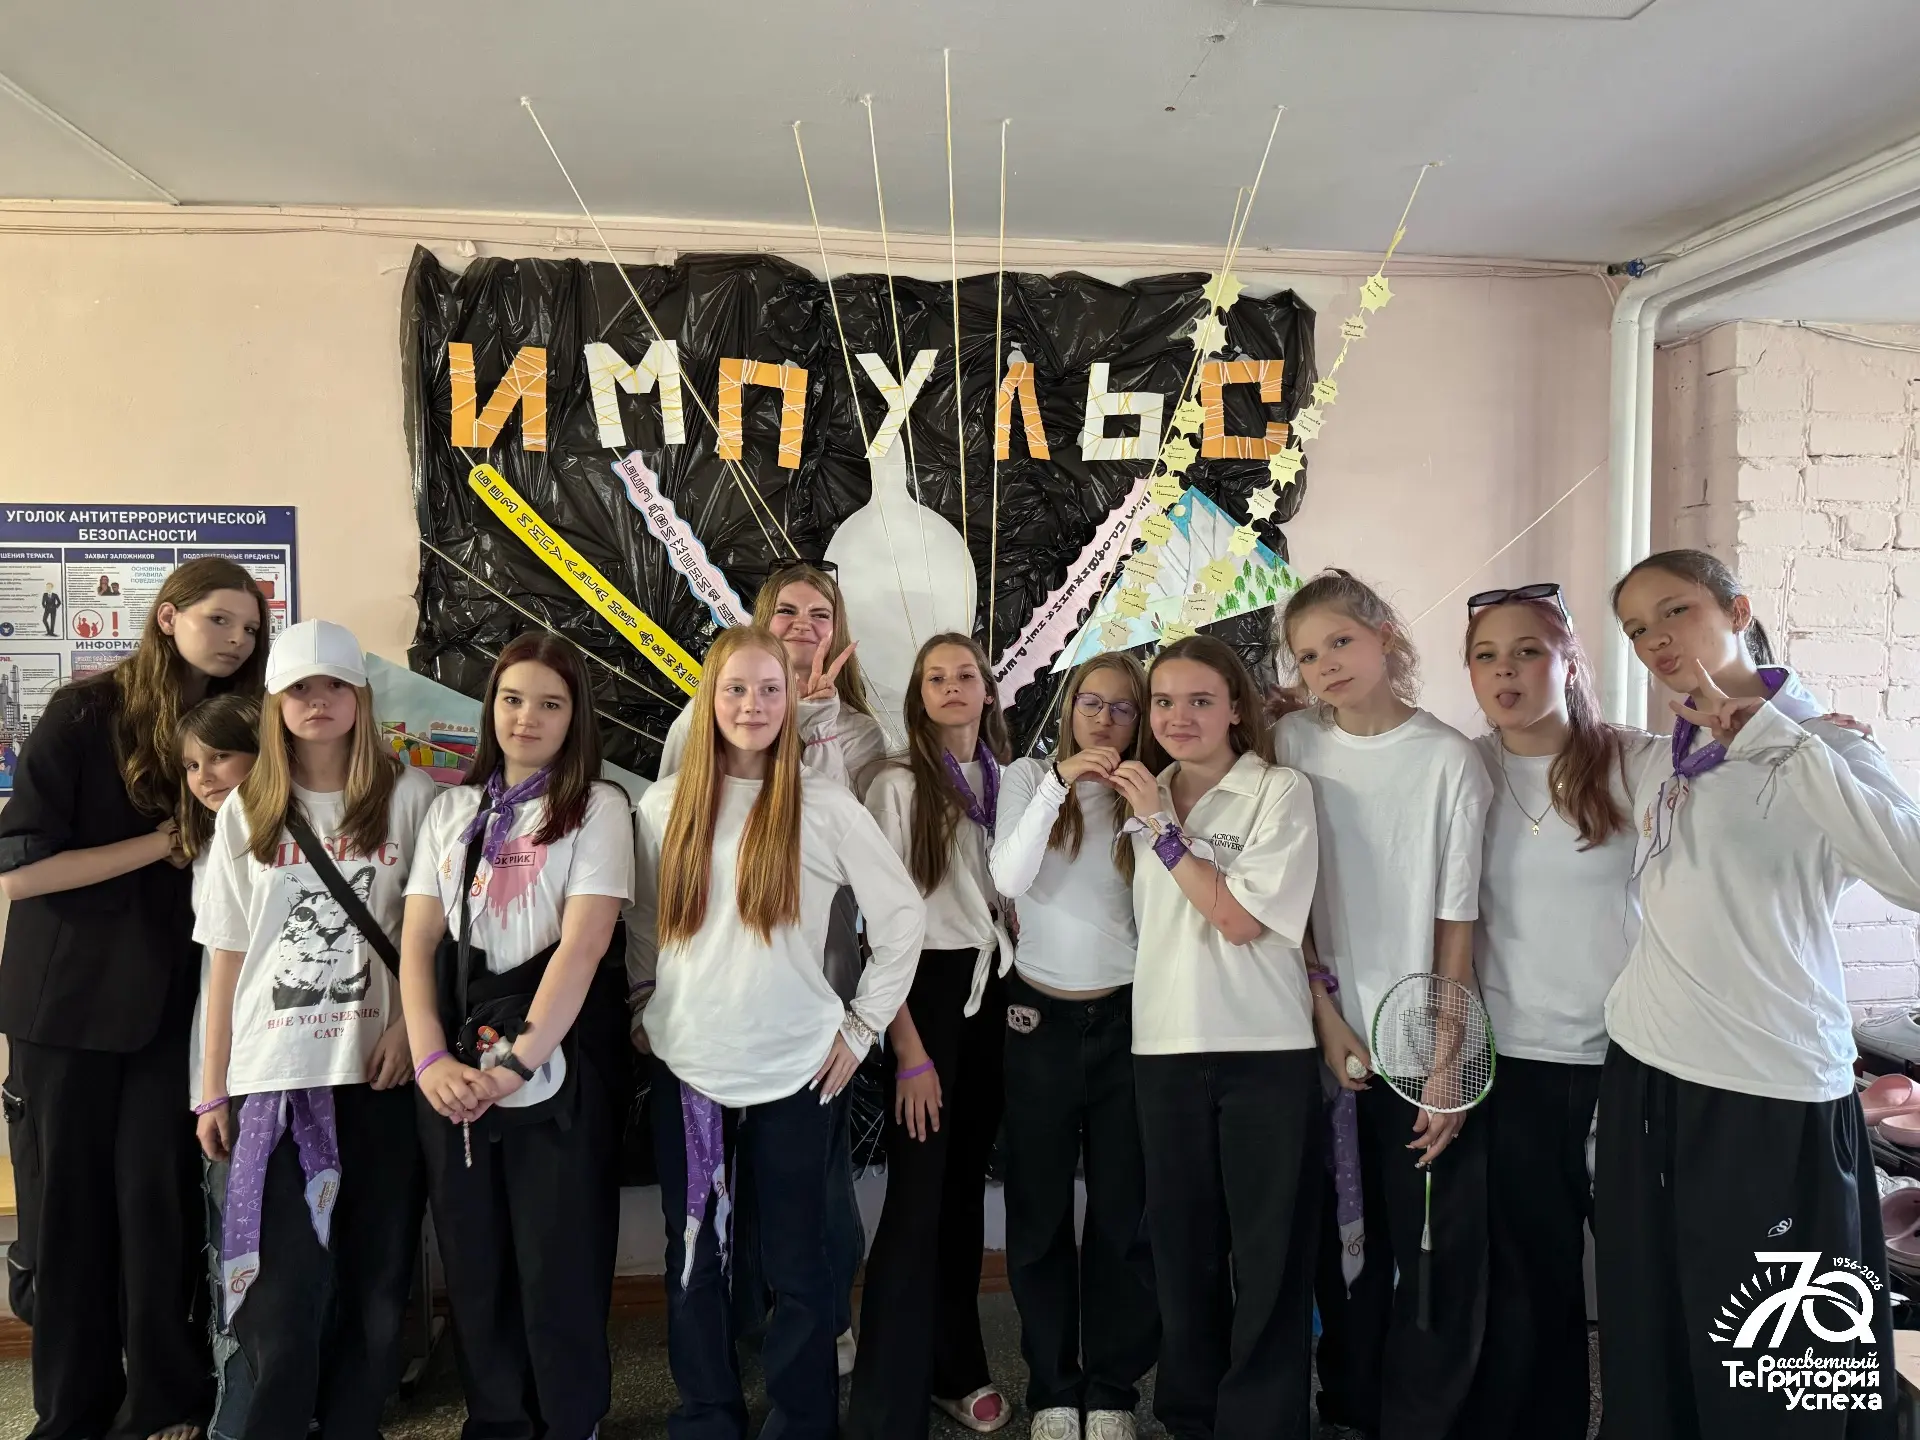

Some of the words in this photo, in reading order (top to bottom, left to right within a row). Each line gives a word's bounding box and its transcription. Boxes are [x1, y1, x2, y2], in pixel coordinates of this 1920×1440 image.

[448, 340, 1289, 469] ИМПУЛЬС
[6, 510, 66, 523] УГОЛОК
[68, 510, 267, 525] АНТИТЕРРОРИСТИЧЕСКОЙ
[78, 529, 197, 541] БЕЗОПАСНОСТИ
[622, 459, 653, 502] БЕЗ
[648, 503, 721, 601] ДВИЖЕНИЯ
[717, 602, 743, 626] НЕ
[475, 470, 518, 513] БЕЗ
[517, 513, 609, 602] ИМПУЛЬСА
[608, 600, 637, 629] НЕТ
[1048, 521, 1126, 620] ПРОДВИЖЕНИЯ
[1025, 621, 1046, 645] НЕТ
[1212, 833, 1240, 842] ACROSS
[299, 1013, 327, 1025] YOU
[314, 1027, 344, 1039] CAT?
